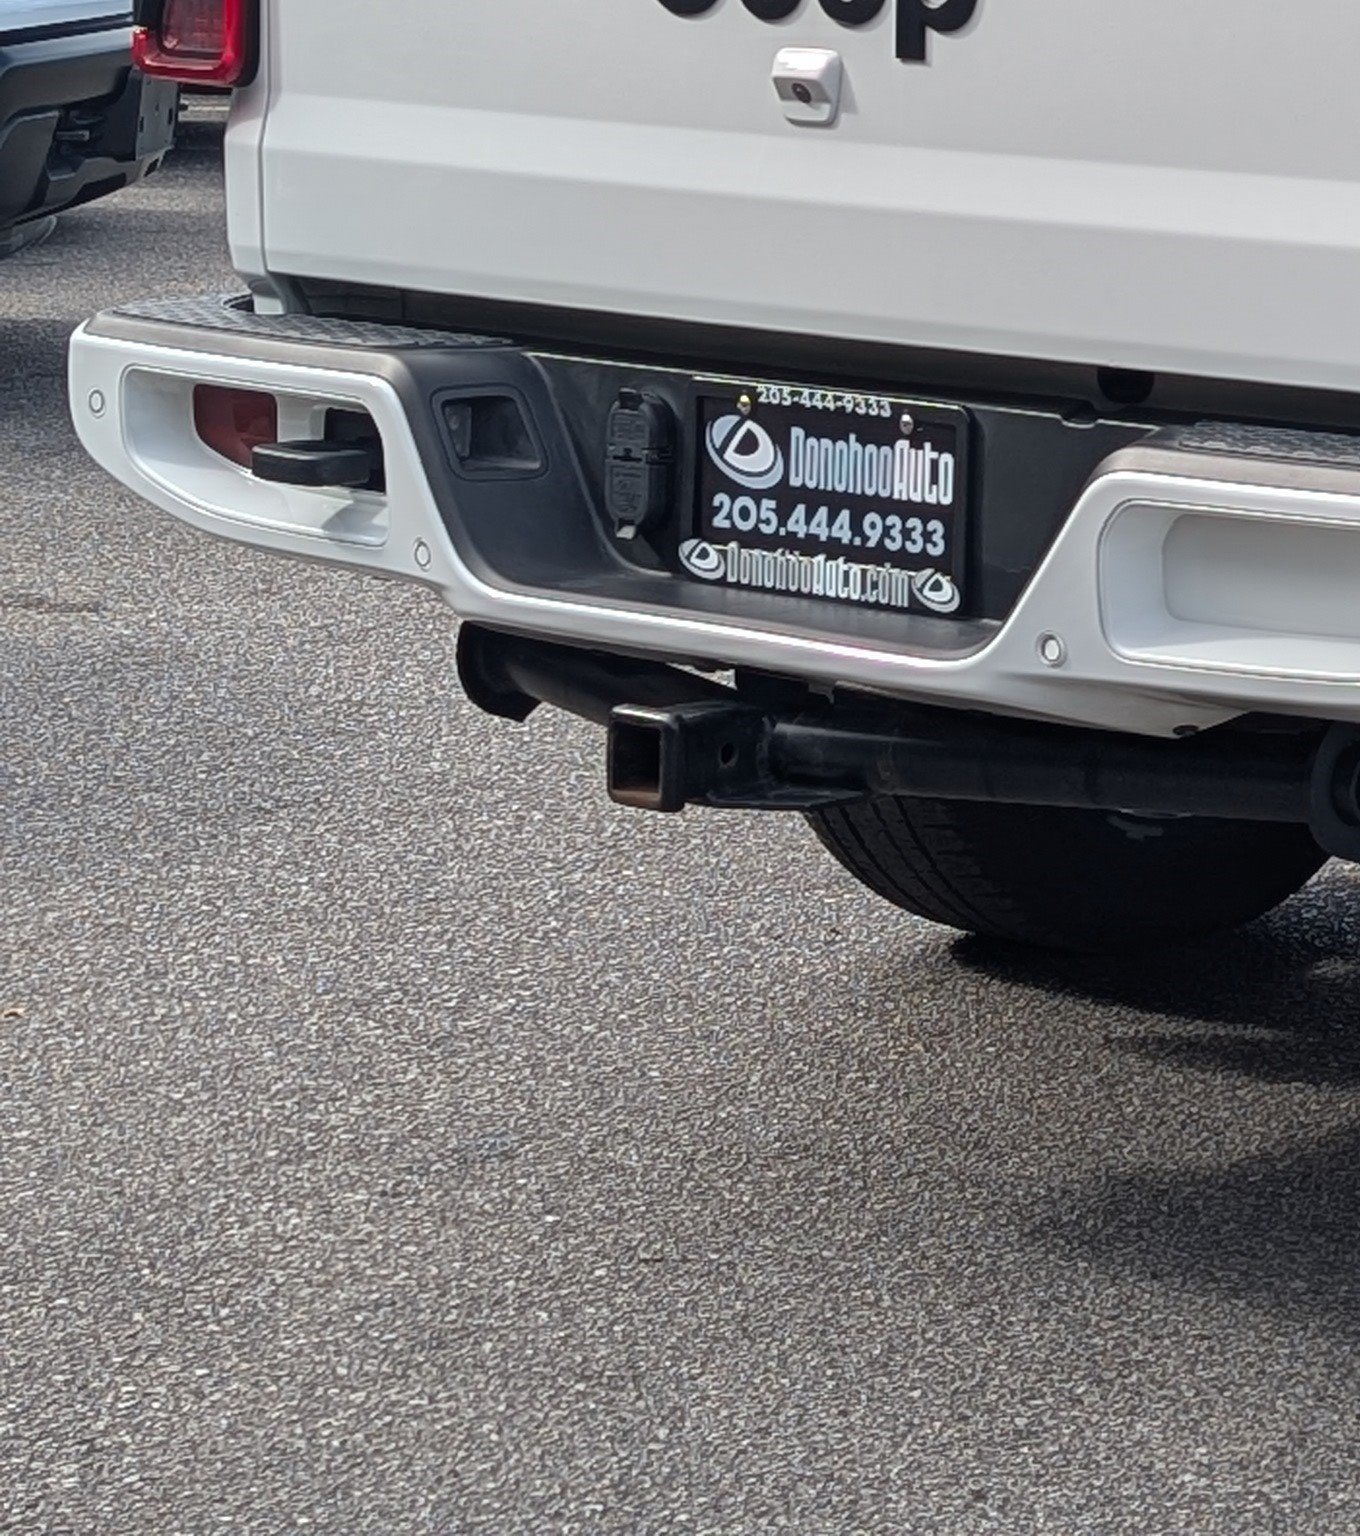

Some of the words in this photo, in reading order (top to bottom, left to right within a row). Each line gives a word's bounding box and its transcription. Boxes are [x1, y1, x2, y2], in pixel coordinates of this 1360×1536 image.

[756, 384, 892, 418] 205-444-9333
[789, 426, 955, 506] DonohooAuto
[711, 493, 945, 557] 205.444.9333
[726, 541, 909, 608] DonohooAuto.com
